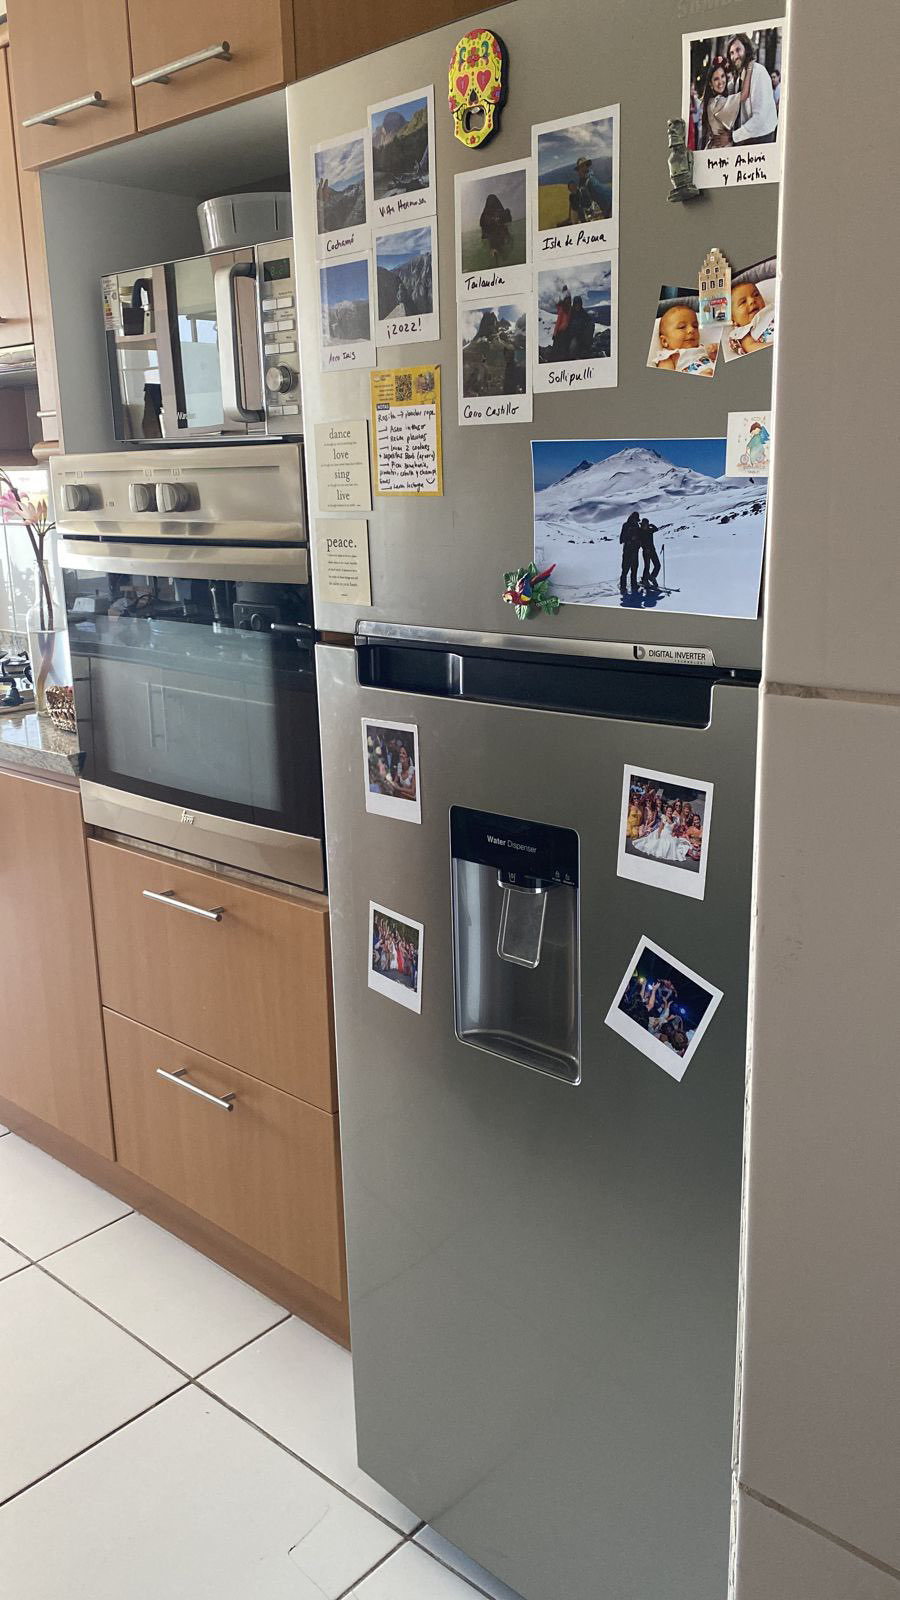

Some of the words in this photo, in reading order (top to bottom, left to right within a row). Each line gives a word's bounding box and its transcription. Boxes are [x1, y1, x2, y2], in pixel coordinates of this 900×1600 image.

[735, 152, 766, 167] Antonia
[723, 174, 728, 185] y
[542, 237, 561, 250] Isla
[565, 235, 573, 246] de
[465, 272, 506, 290] Tailandia
[386, 318, 422, 339] ¡2022!
[486, 402, 519, 417] Castillo
[329, 428, 351, 439] dance
[333, 448, 349, 460] love
[334, 469, 350, 482] sing
[337, 489, 350, 500] live
[327, 538, 357, 552] peace.
[649, 650, 673, 658] DIGITAL
[675, 651, 705, 660] INVERTER
[487, 834, 506, 846] Water
[507, 840, 537, 853] Dispenser
